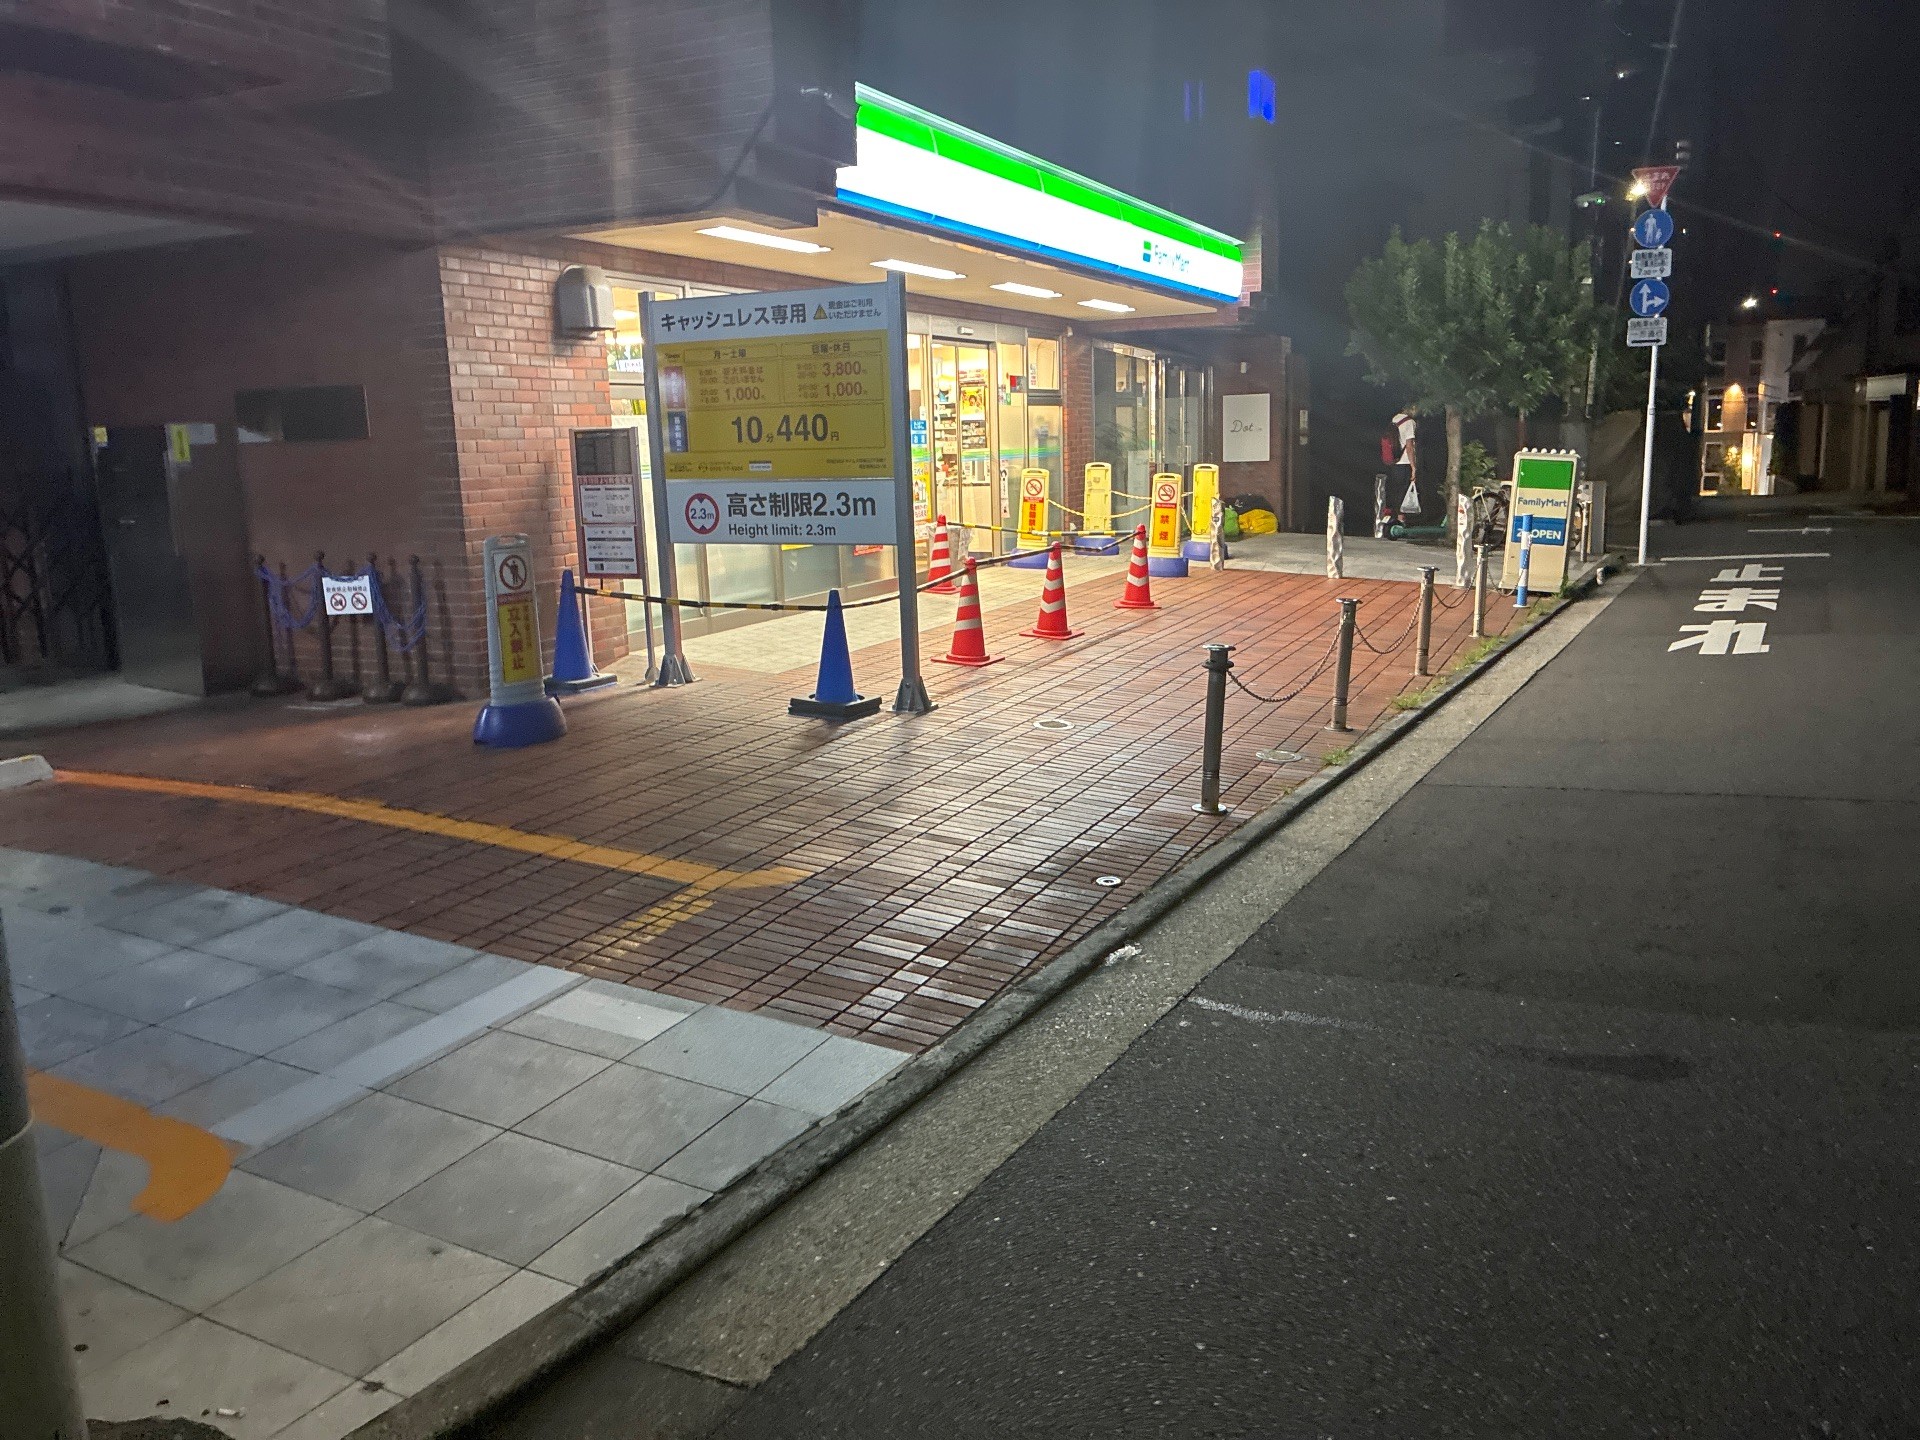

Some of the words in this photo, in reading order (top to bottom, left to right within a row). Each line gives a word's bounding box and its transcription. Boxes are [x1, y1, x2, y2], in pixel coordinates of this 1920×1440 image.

[828, 298, 873, 310] 現金はご利用
[661, 303, 807, 333] キャッシュレス専用
[828, 309, 882, 321] いただけません
[726, 492, 877, 518] 高さ制限2.3m
[1518, 497, 1567, 508] FamilyMart
[690, 507, 715, 520] 2.3m
[728, 524, 768, 538] Height
[772, 524, 802, 536] limit:
[805, 524, 837, 536] 2.3m
[1532, 529, 1562, 540] OPEN
[1667, 563, 1785, 655] 止まれ
